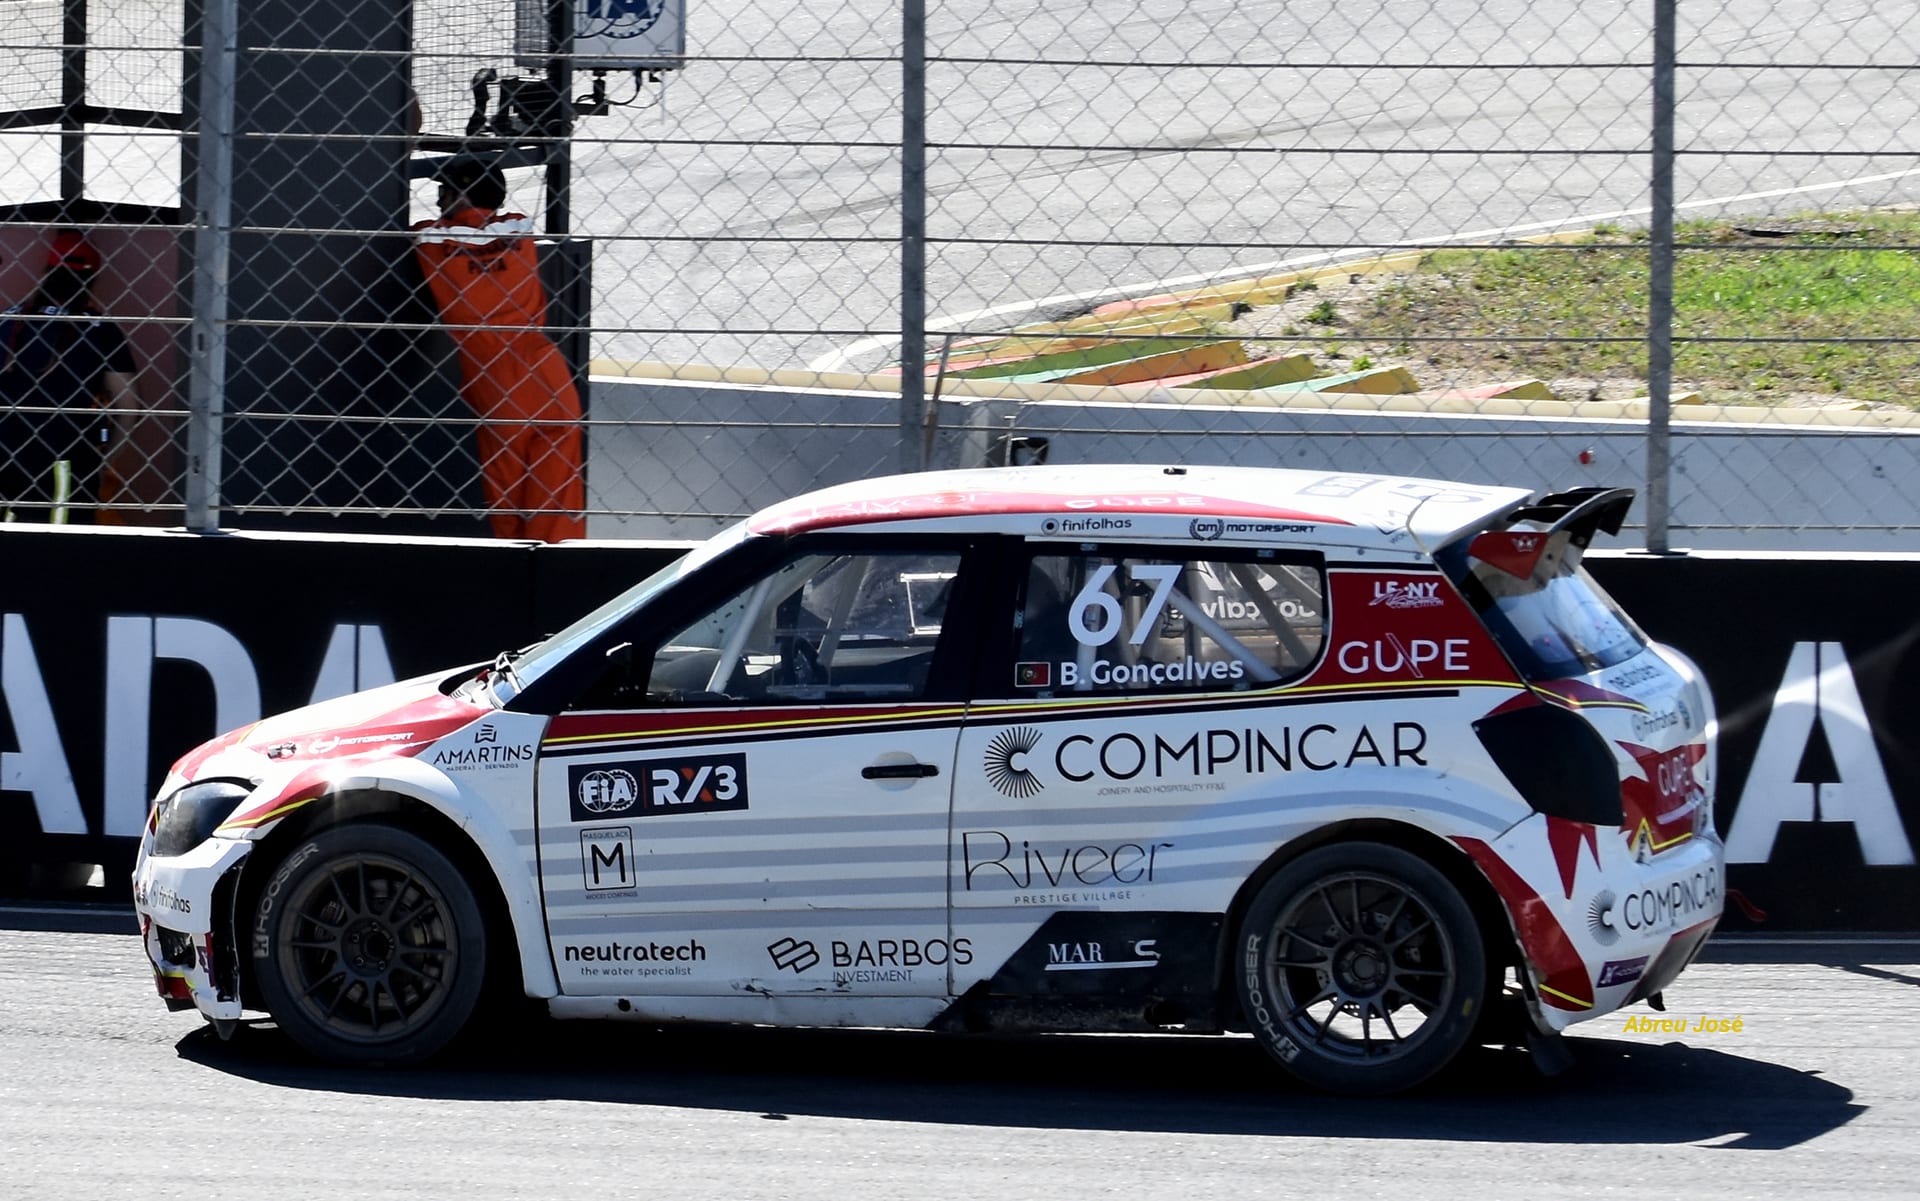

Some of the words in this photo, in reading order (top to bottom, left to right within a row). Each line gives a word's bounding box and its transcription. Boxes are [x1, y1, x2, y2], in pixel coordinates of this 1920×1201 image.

[1062, 518, 1132, 531] finifolhas
[1226, 523, 1317, 534] MOTORSPORT
[1068, 564, 1184, 647] 67
[1060, 662, 1085, 686] B.
[1091, 655, 1245, 685] Gonçalves
[1338, 638, 1470, 675] GUPE
[433, 744, 533, 764] AMARTINS
[1055, 721, 1428, 782] COMPINCAR
[652, 765, 739, 806] RX3
[1097, 786, 1131, 796] JOINERY
[1134, 785, 1152, 794] AND
[1154, 783, 1204, 793] HOSPITALITY
[591, 841, 626, 885] M
[962, 830, 1175, 892] Riveer
[256, 843, 320, 933] HOOSIER
[1015, 893, 1079, 905] PRESTIGE
[1083, 890, 1132, 902] VILLAGE
[565, 939, 706, 962] neutratech
[831, 938, 974, 968] BARBOS
[581, 967, 599, 976] the
[602, 967, 634, 976] water
[638, 966, 692, 978] specialist
[832, 970, 913, 984] INVESTMENT
[1245, 934, 1282, 1042] HOOSIER
